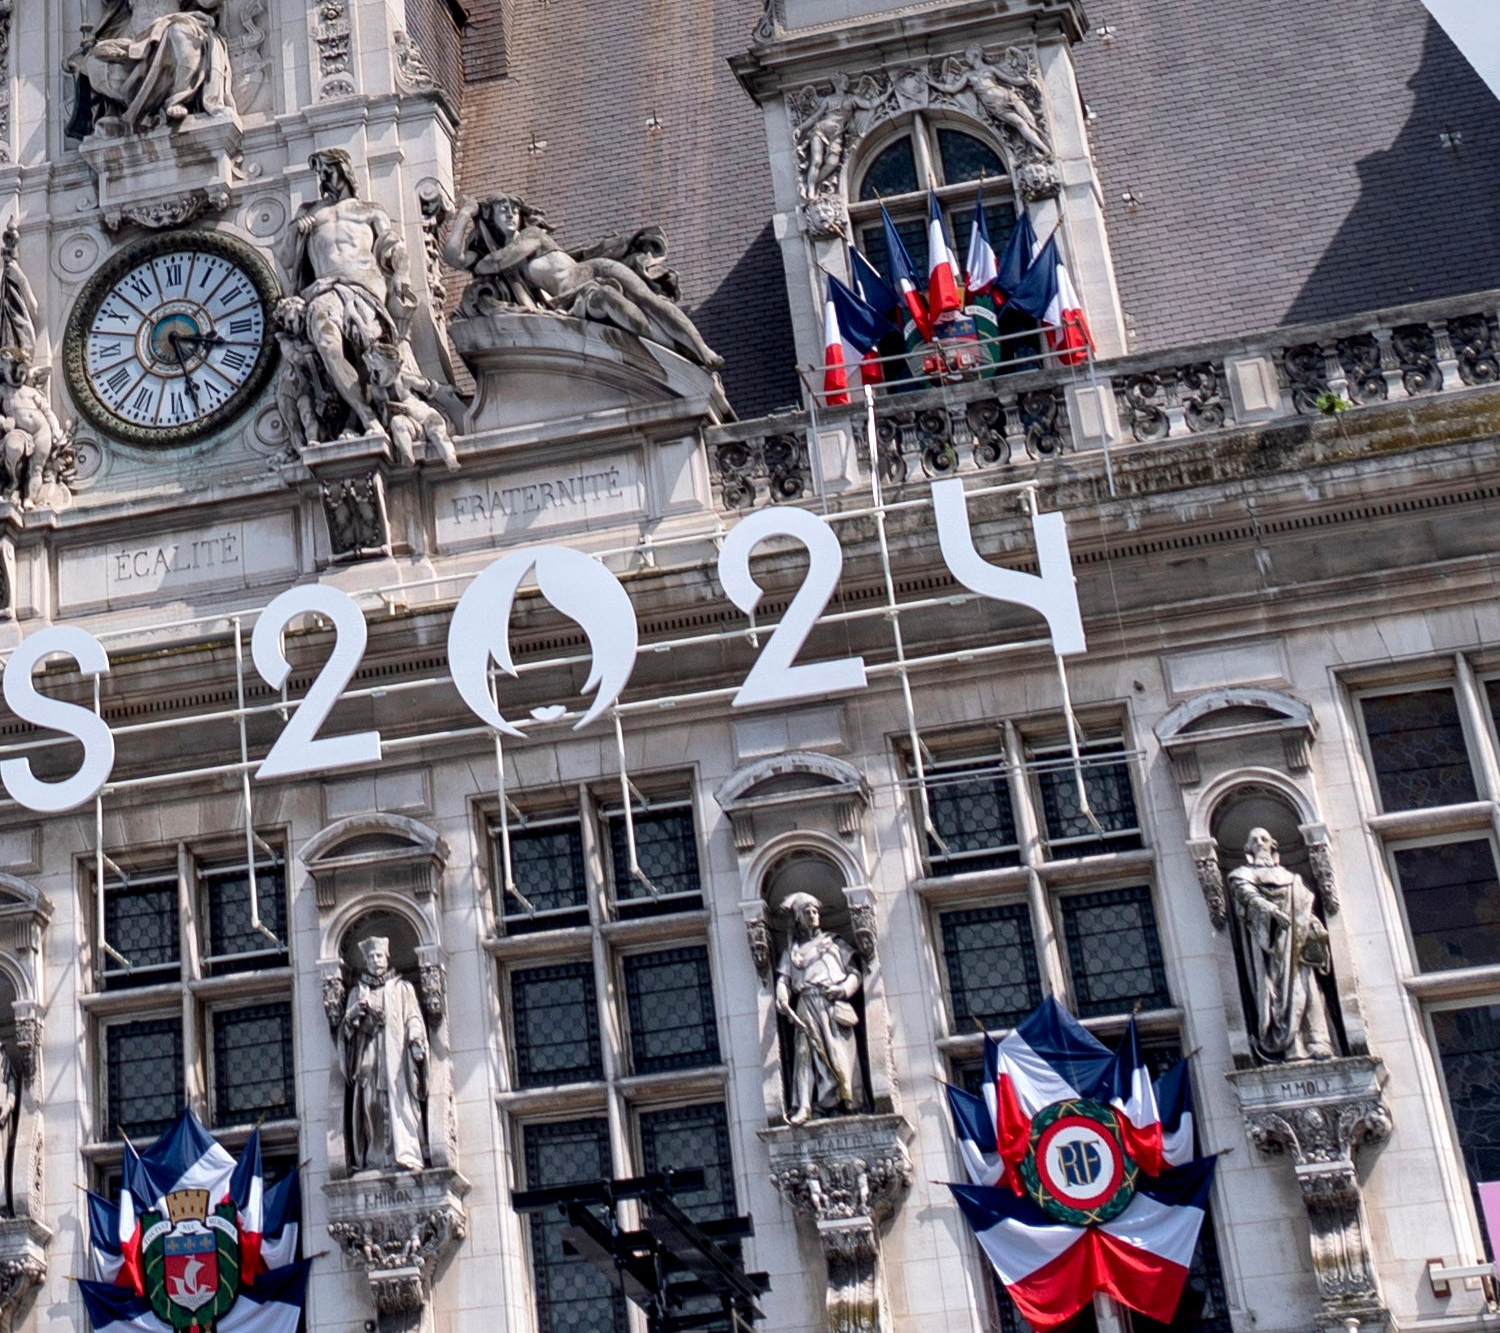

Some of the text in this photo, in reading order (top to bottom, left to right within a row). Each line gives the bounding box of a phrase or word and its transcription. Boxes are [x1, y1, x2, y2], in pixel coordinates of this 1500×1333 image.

[165, 263, 183, 288] XII
[198, 266, 213, 289] I
[131, 278, 153, 302] XI
[219, 285, 243, 307] II
[107, 309, 130, 324] X
[229, 317, 253, 334] III
[451, 465, 623, 525] FRATERNITÉ
[251, 477, 1088, 780] 2024
[1055, 1139, 1100, 1187] RF
